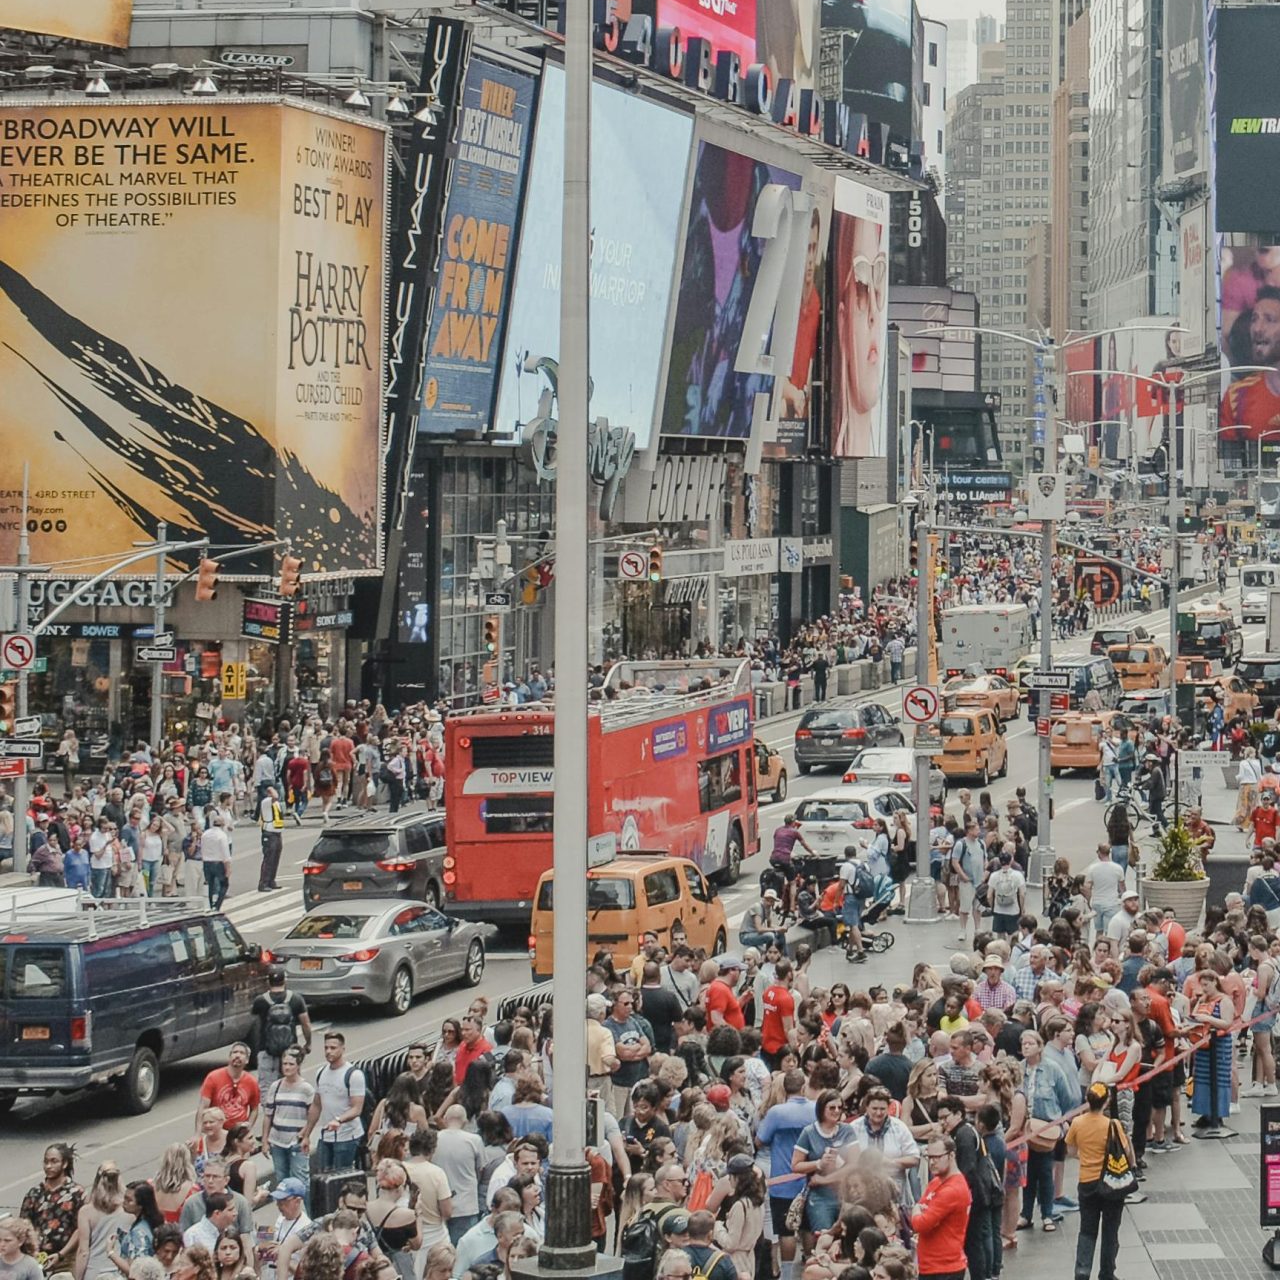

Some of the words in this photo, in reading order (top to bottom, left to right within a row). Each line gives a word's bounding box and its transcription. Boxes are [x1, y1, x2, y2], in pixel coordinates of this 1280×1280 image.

[685, 37, 891, 166] BROADWAY
[168, 116, 235, 137] WILL
[483, 113, 522, 157] MUSICAL
[315, 127, 356, 153] WINNER!
[1, 145, 64, 167] EVER
[74, 145, 105, 166] BE
[114, 144, 167, 165] THE
[175, 142, 255, 164] SAME.
[296, 146, 302, 163] 6
[304, 147, 331, 170] TONY
[333, 155, 372, 180] AWARDS
[9, 173, 113, 187] THEATRICAL
[119, 172, 186, 186] MARVEL
[192, 171, 239, 185] THAT
[1, 193, 79, 207] EDEFINES
[85, 193, 118, 206] THE
[124, 191, 237, 206] POSSIBILITIES
[293, 183, 331, 221] BEST
[336, 192, 373, 228] PLAY
[866, 192, 885, 210] PRADA
[55, 213, 79, 227] OF
[908, 190, 921, 247] 1500
[447, 213, 510, 269] COME
[599, 238, 632, 272] YOUR
[294, 250, 370, 318] HARRY
[439, 261, 504, 316] FROM
[287, 307, 372, 371] POTTER
[431, 310, 498, 362] AWAY
[317, 371, 329, 382] AND
[330, 371, 341, 383] THE
[296, 383, 331, 405] CURSED
[333, 386, 363, 406] CHILD
[35, 490, 59, 499] 43RD
[61, 490, 96, 499] STREET
[302, 577, 355, 599] LUGGAGE
[82, 625, 120, 637] BOWER
[316, 614, 337, 627] SONY
[224, 665, 235, 694] ATM
[1048, 676, 1064, 684] WAY
[532, 725, 550, 736] 314
[491, 771, 553, 784] TOPVIEW
